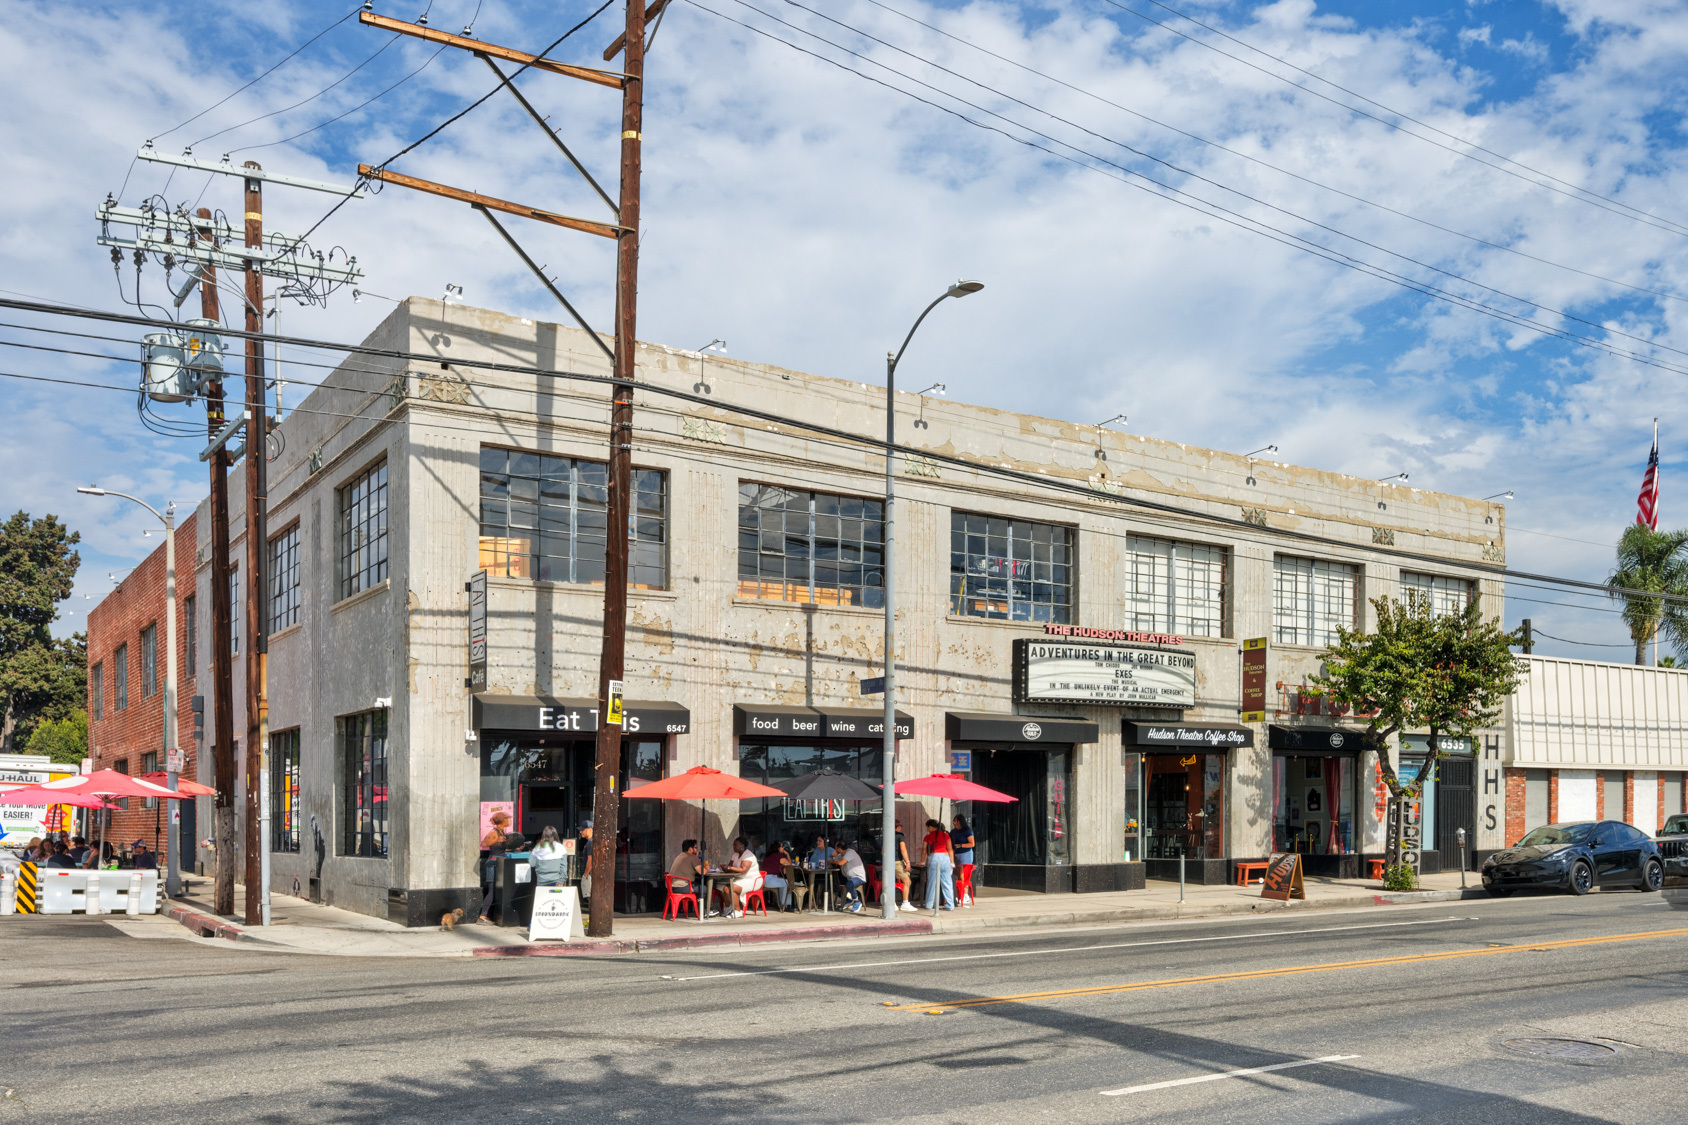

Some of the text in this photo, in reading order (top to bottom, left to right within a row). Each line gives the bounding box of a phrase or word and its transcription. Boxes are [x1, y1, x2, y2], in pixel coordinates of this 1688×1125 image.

[472, 577, 486, 657] EAT THIS
[1046, 624, 1184, 645] THE HUDSON THEATRES
[1030, 646, 1194, 669] ADVENTURES IN THE GREAT BEYOND
[472, 668, 484, 684] Café
[1115, 670, 1133, 679] EXES
[539, 708, 640, 732] Eat Tis
[667, 724, 686, 733] 6547
[752, 718, 909, 736] food beer wine cating
[1148, 728, 1245, 745] Hudson Theatre Coffee Shop
[1441, 739, 1464, 750] 6535
[524, 760, 547, 768] 6547
[4, 811, 33, 819] EASIER!
[787, 798, 842, 819] EAT THIS
[1054, 779, 1063, 838] GUILD
